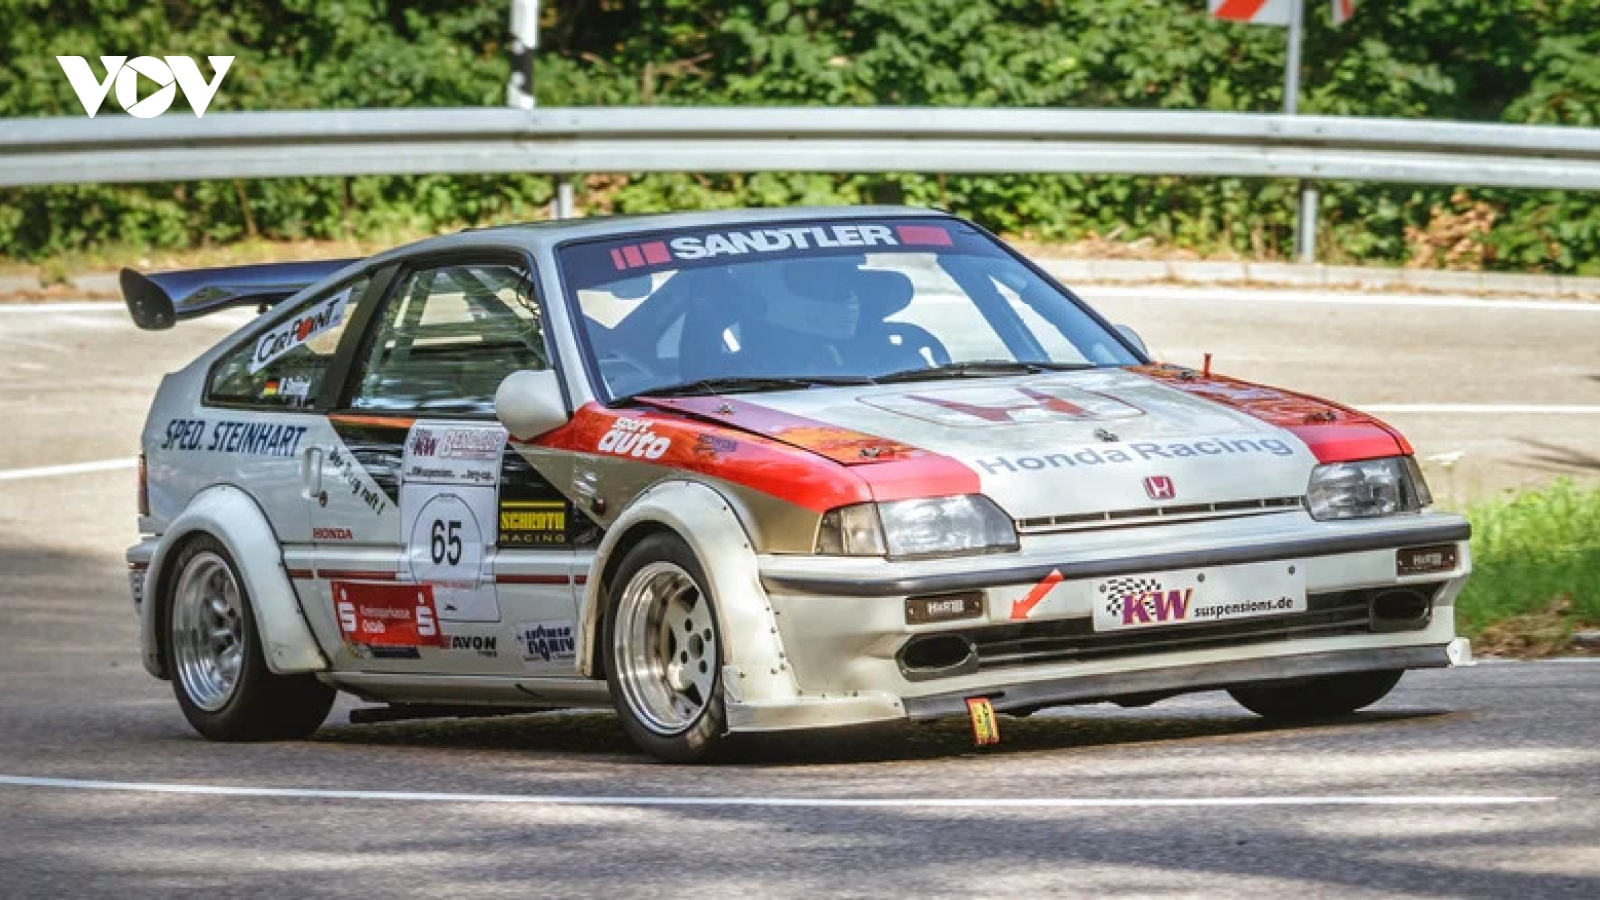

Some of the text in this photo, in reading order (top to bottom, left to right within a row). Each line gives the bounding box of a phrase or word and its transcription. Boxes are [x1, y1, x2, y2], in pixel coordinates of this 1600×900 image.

[670, 225, 899, 260] SANDTLER
[161, 419, 308, 457] SPED. STEINHART
[598, 430, 671, 459] auto
[976, 437, 1294, 475] Honda Racing
[312, 527, 352, 540] HONDA
[431, 519, 462, 565] 65
[499, 533, 566, 543] RACING
[1122, 588, 1294, 625] KW suspensions.de
[452, 636, 497, 649] AVON
